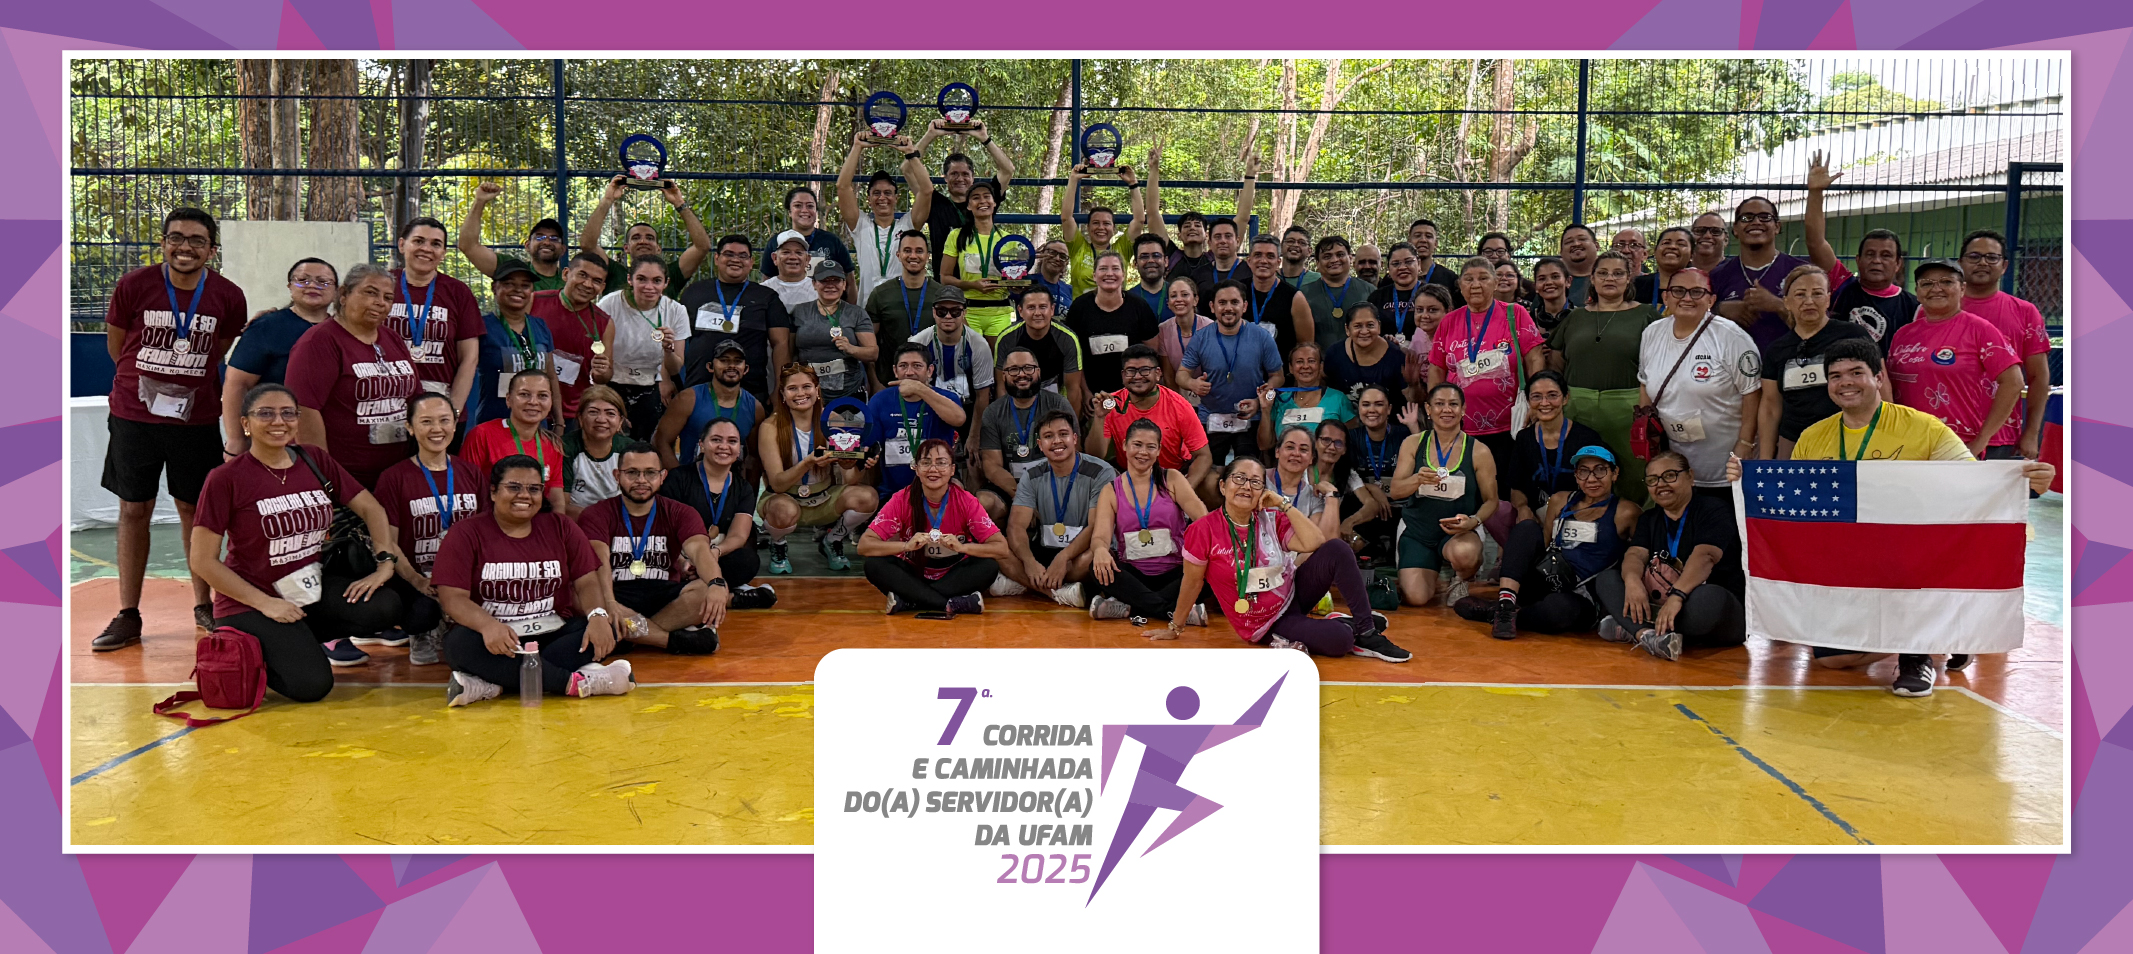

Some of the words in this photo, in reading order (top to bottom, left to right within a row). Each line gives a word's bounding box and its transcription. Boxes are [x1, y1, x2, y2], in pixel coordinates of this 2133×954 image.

[143, 310, 187, 329] ORGULO
[711, 317, 724, 326] 17
[141, 325, 213, 354] ODOTO
[1103, 343, 1115, 352] 70
[136, 347, 174, 365] UFAM
[1897, 352, 1925, 365] Rosa
[819, 364, 832, 375] 80
[1477, 357, 1491, 369] 60
[1801, 371, 1817, 384] 29
[355, 373, 417, 402] ODONTO
[175, 403, 184, 415] 1
[356, 399, 392, 416] UFAM
[1223, 420, 1234, 429] 64
[1671, 423, 1685, 432] 18
[898, 445, 911, 455] 30
[1433, 482, 1448, 492] 30
[256, 492, 304, 516] ORGULHO
[1563, 527, 1578, 539] 53
[928, 546, 942, 555] 01
[481, 562, 528, 581] ORGULHO
[529, 561, 542, 579] DE
[543, 560, 562, 578] SER
[302, 575, 320, 589] 81
[479, 577, 562, 604] ODONTO
[523, 621, 542, 634] 26
